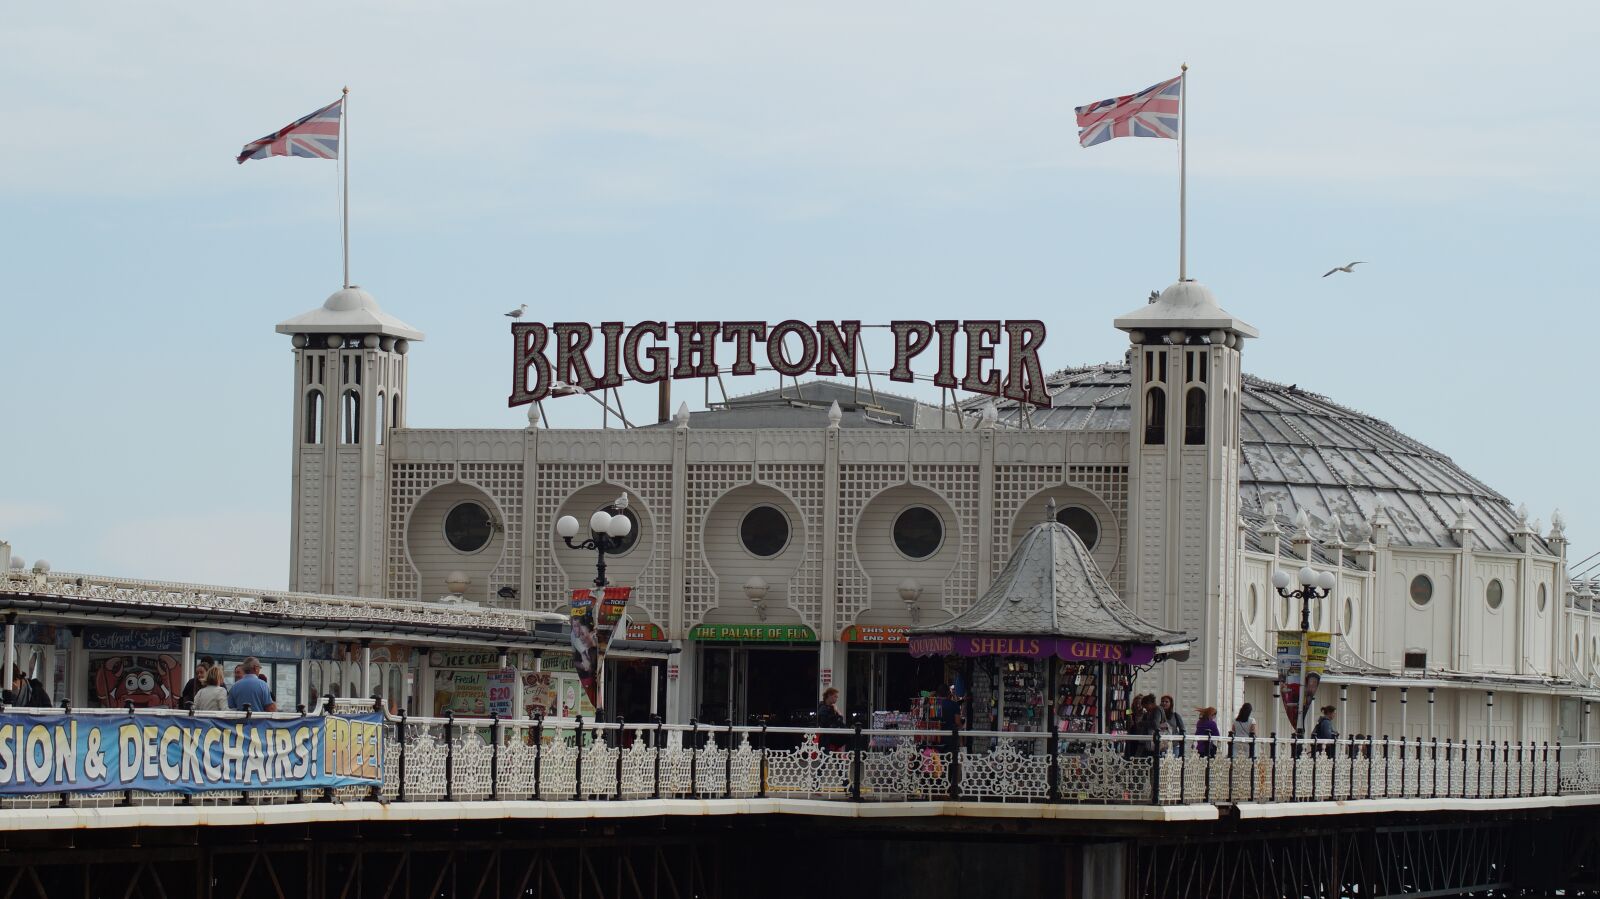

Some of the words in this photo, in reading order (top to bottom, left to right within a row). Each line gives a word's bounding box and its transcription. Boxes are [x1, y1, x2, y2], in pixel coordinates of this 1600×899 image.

[508, 320, 861, 408] BRIGHTON
[890, 320, 1053, 409] PIER
[88, 630, 135, 648] Seafood
[696, 627, 716, 638] THE
[721, 627, 762, 638] PALACE
[768, 628, 782, 638] OF
[787, 628, 810, 639] FUN
[909, 638, 952, 652] SOUVENIRS
[970, 639, 1039, 655] SHELLS
[1071, 640, 1122, 660] GIFTS
[446, 656, 465, 666] ICE
[455, 674, 480, 684] Fresh!
[522, 673, 550, 687] LOVE
[489, 687, 510, 701] £20
[0, 720, 78, 784] SION
[85, 727, 108, 780] &
[118, 722, 319, 785] DECKCHAIRS!
[324, 717, 383, 780] FREE!
